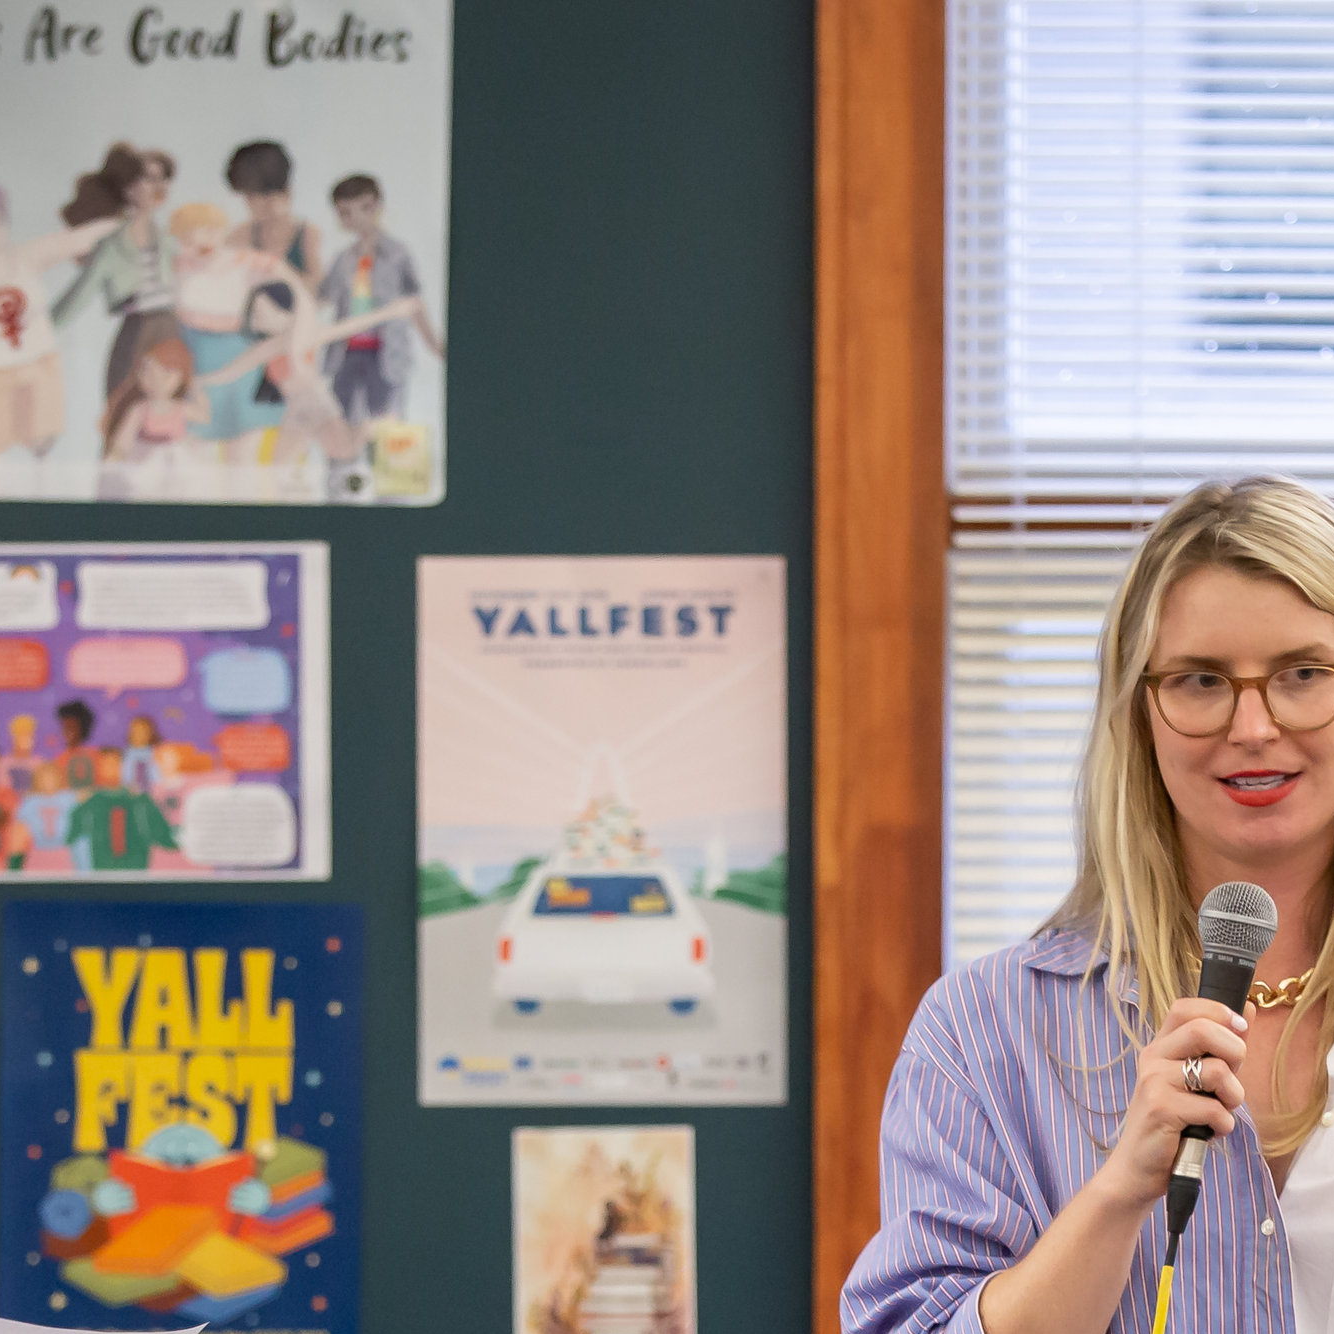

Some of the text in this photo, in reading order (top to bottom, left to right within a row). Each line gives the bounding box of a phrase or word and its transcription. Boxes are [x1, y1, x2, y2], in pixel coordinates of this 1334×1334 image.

[23, 7, 103, 63] Are
[129, 3, 239, 67] Good
[266, 5, 410, 69] Bodies
[472, 604, 736, 638] YALLFEST
[71, 946, 297, 1049] YALL
[73, 1049, 296, 1153] FEST
